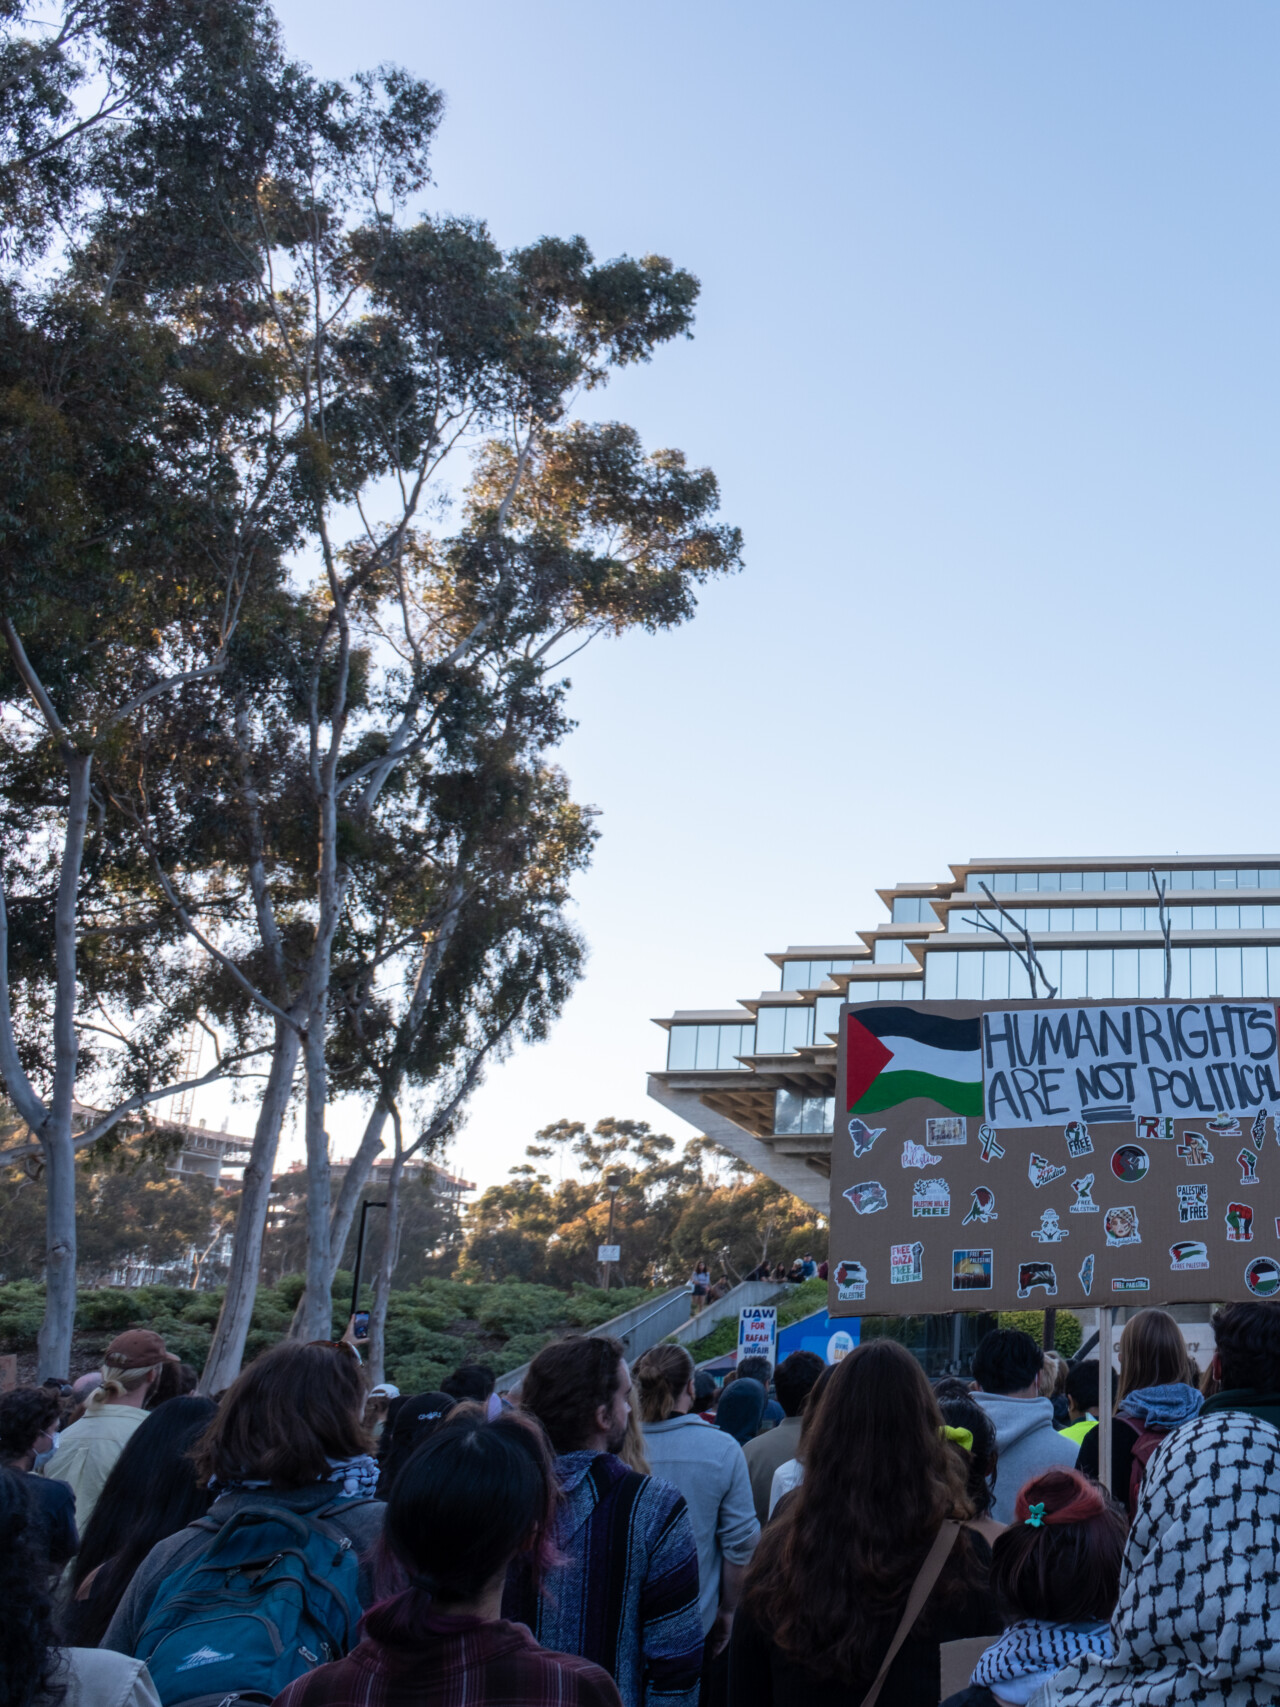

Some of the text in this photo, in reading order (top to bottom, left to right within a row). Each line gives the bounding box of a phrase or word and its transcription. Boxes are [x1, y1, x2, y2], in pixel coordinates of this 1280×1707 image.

[983, 1005, 1277, 1068] HUMAN RIGHTS
[988, 1067, 1070, 1122] ARE
[1076, 1062, 1138, 1107] NOT
[1138, 1115, 1173, 1138] FREE
[905, 1141, 923, 1156] Free
[1068, 1137, 1091, 1151] FREE
[1071, 1146, 1093, 1156] PALESTINE
[902, 1154, 941, 1167] Palestine
[1177, 1185, 1207, 1196] PALESTINE
[1189, 1206, 1207, 1220] FREE
[892, 1246, 911, 1255] FREE
[892, 1255, 913, 1265] GAZA
[892, 1265, 911, 1275] FREE
[892, 1274, 922, 1283] PALESTINE
[839, 1292, 865, 1300] PALESTINE
[743, 1309, 775, 1318] UAW
[745, 1334, 769, 1342] RAFAH
